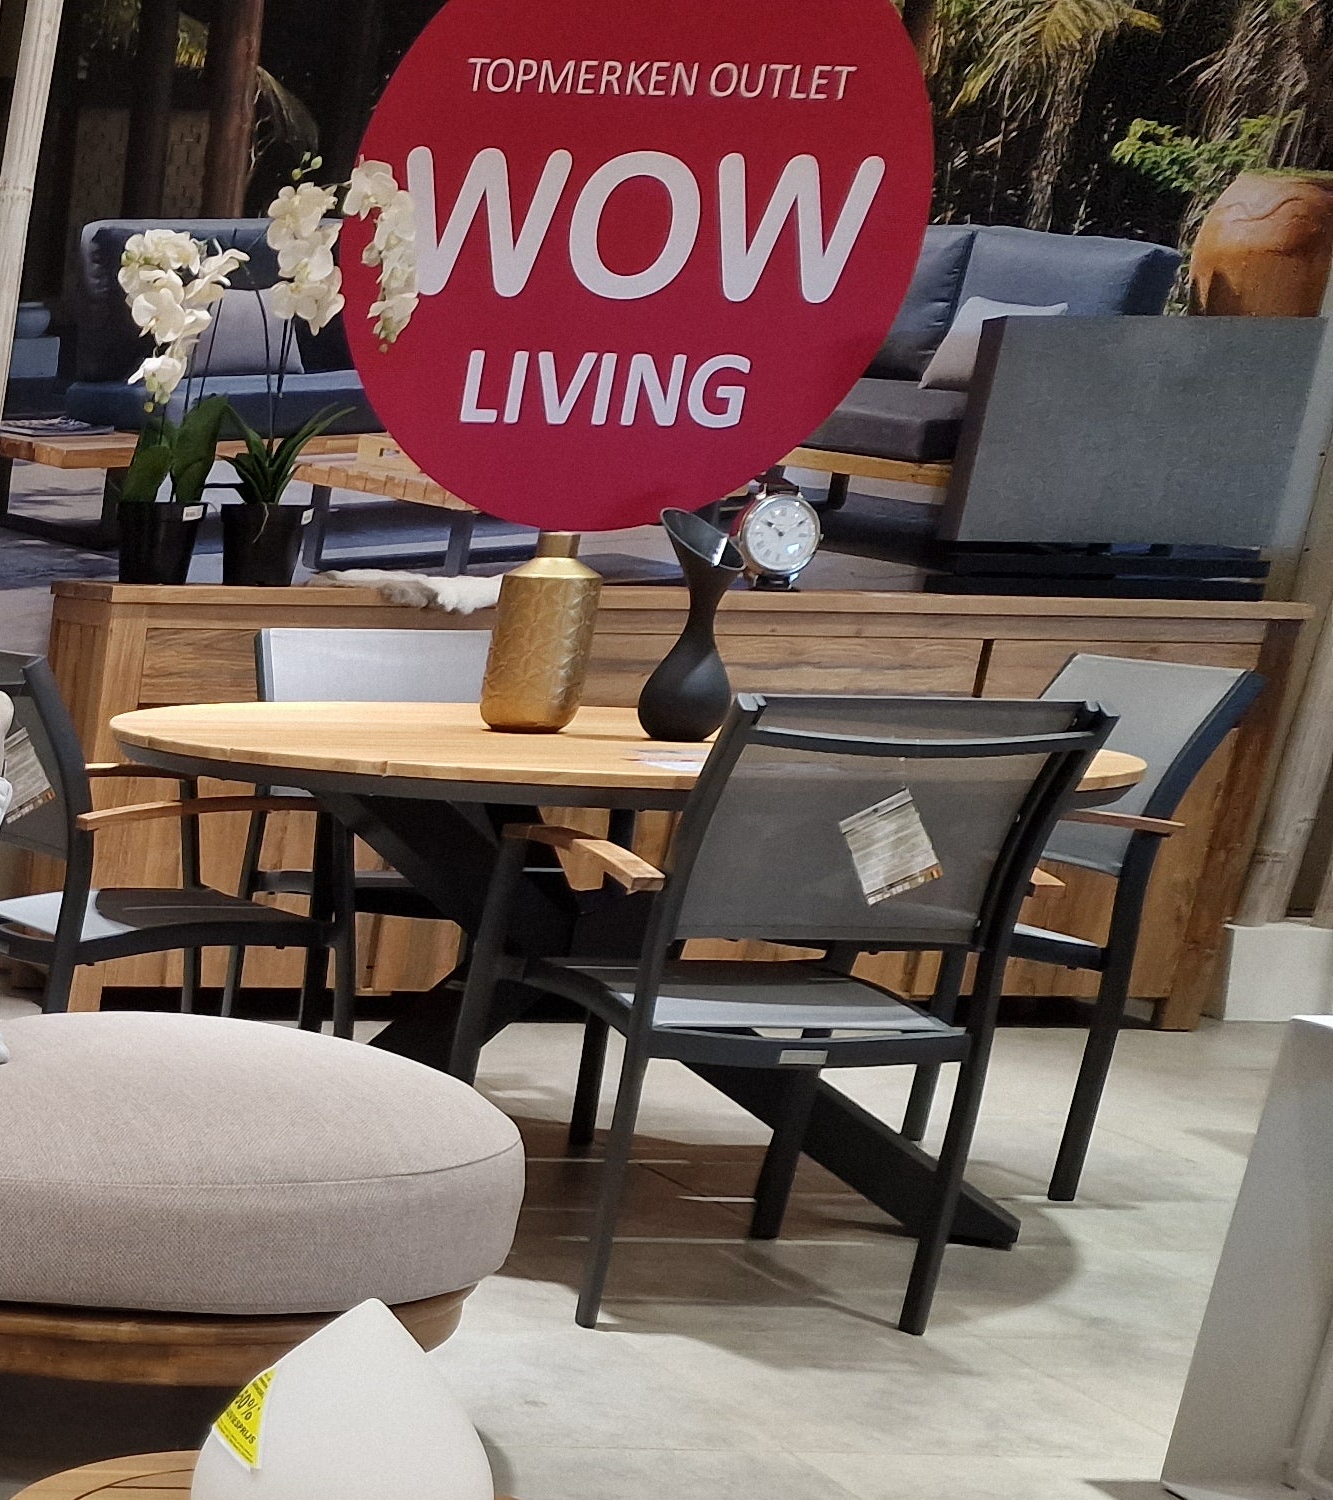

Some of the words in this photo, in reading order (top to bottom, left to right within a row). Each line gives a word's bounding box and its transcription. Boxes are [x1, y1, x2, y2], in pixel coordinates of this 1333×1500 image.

[467, 57, 699, 98] TOPMERKEN
[708, 62, 857, 101] OUTLET
[406, 145, 886, 305] WOW
[459, 349, 751, 429] LIVING
